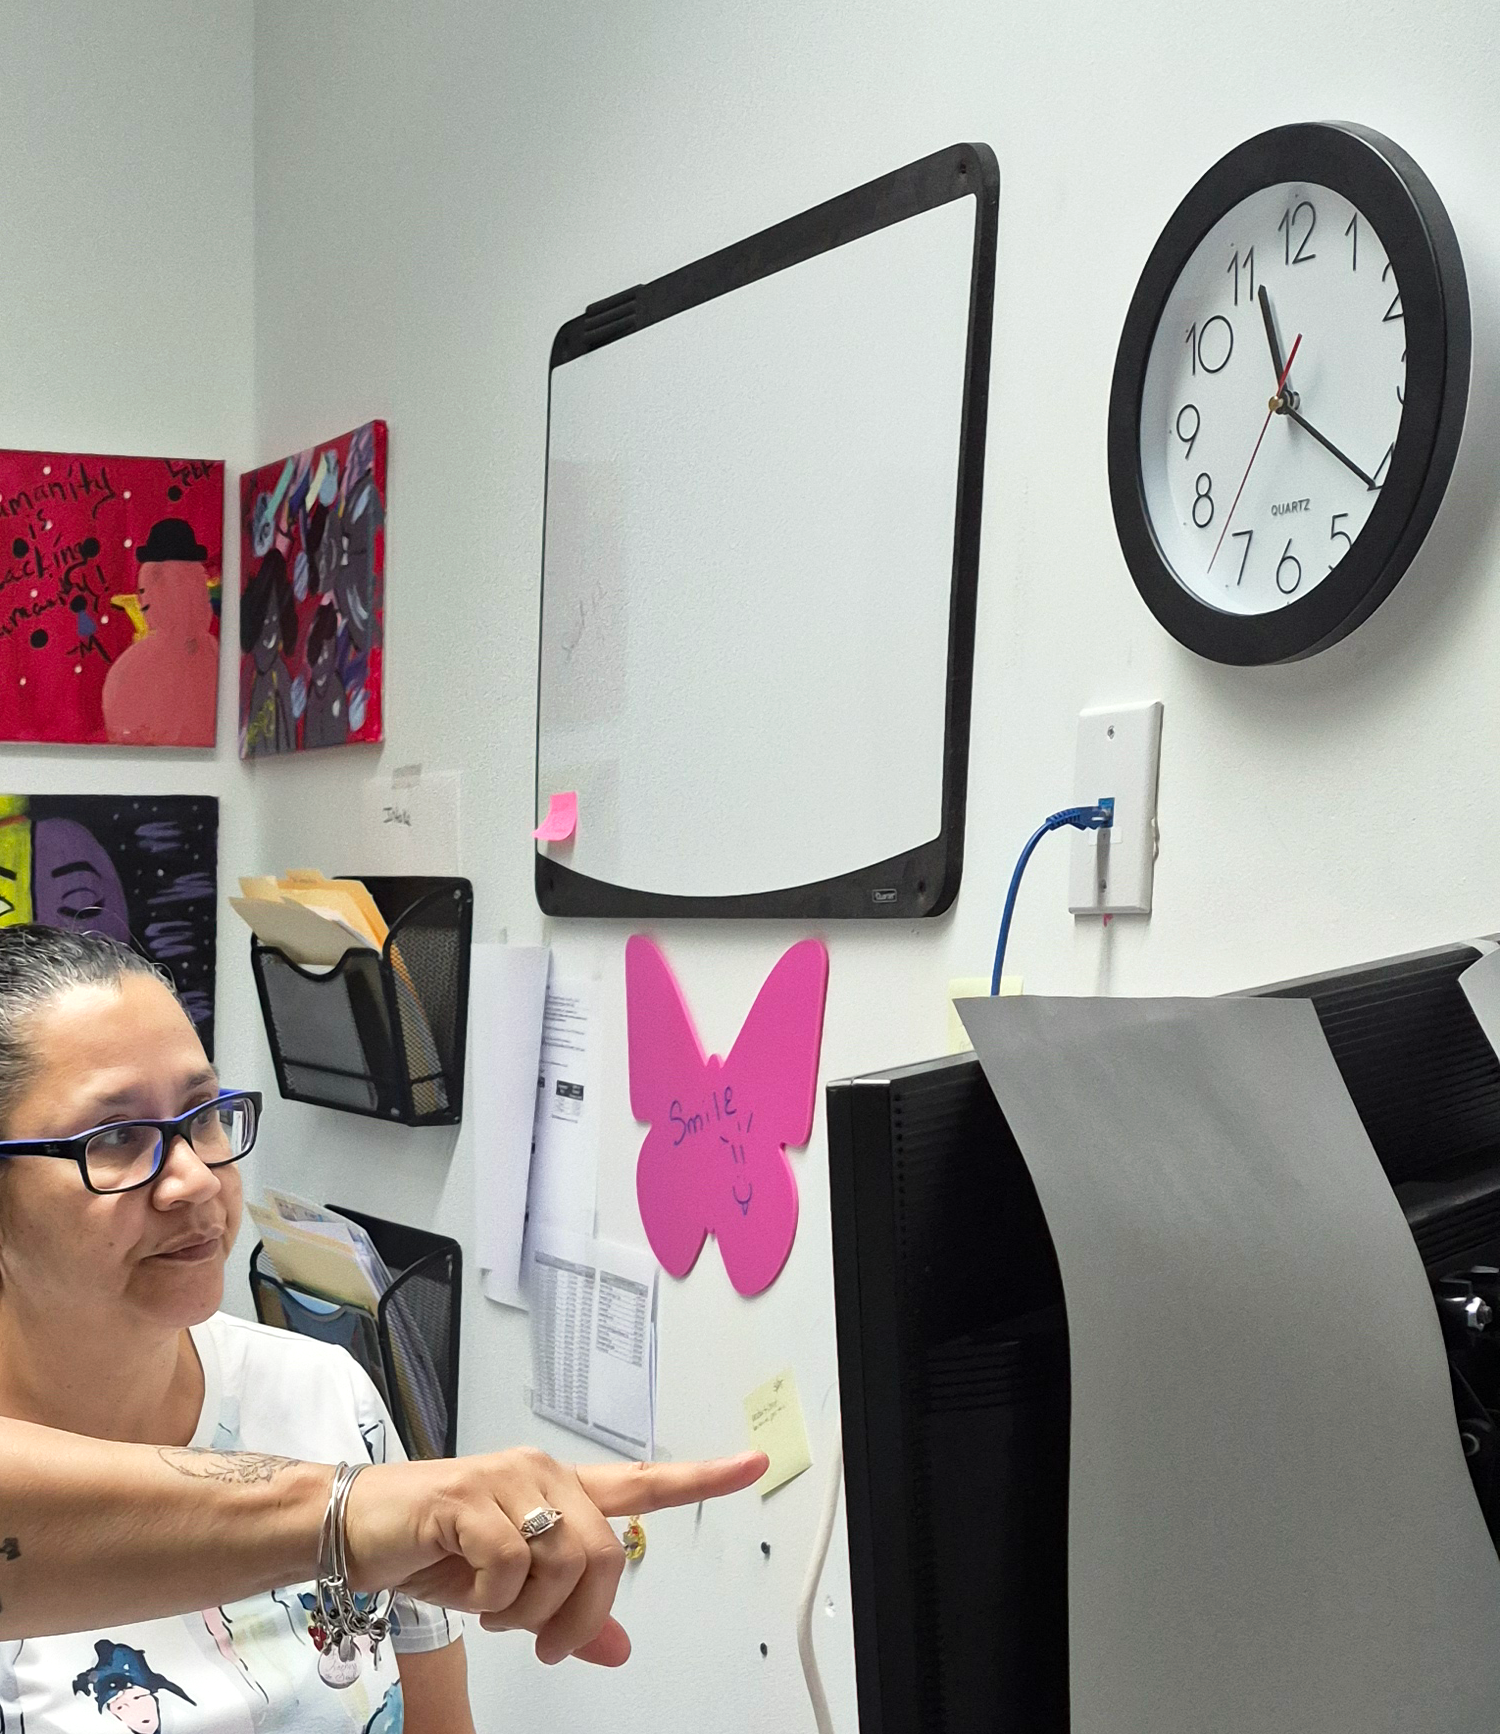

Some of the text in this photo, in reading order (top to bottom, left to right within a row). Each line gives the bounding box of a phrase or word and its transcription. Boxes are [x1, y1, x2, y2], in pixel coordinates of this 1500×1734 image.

[1277, 201, 1317, 266] 12
[1345, 212, 1357, 271] 1
[1227, 244, 1256, 306] 11
[1185, 314, 1234, 376] 10
[1176, 404, 1200, 459] 9
[1192, 472, 1215, 528] 8
[1270, 498, 1311, 518] QUARTZ
[1232, 529, 1253, 586] 7
[1276, 538, 1302, 594] 6
[1328, 512, 1352, 572] 5
[669, 1086, 737, 1146] Smile
